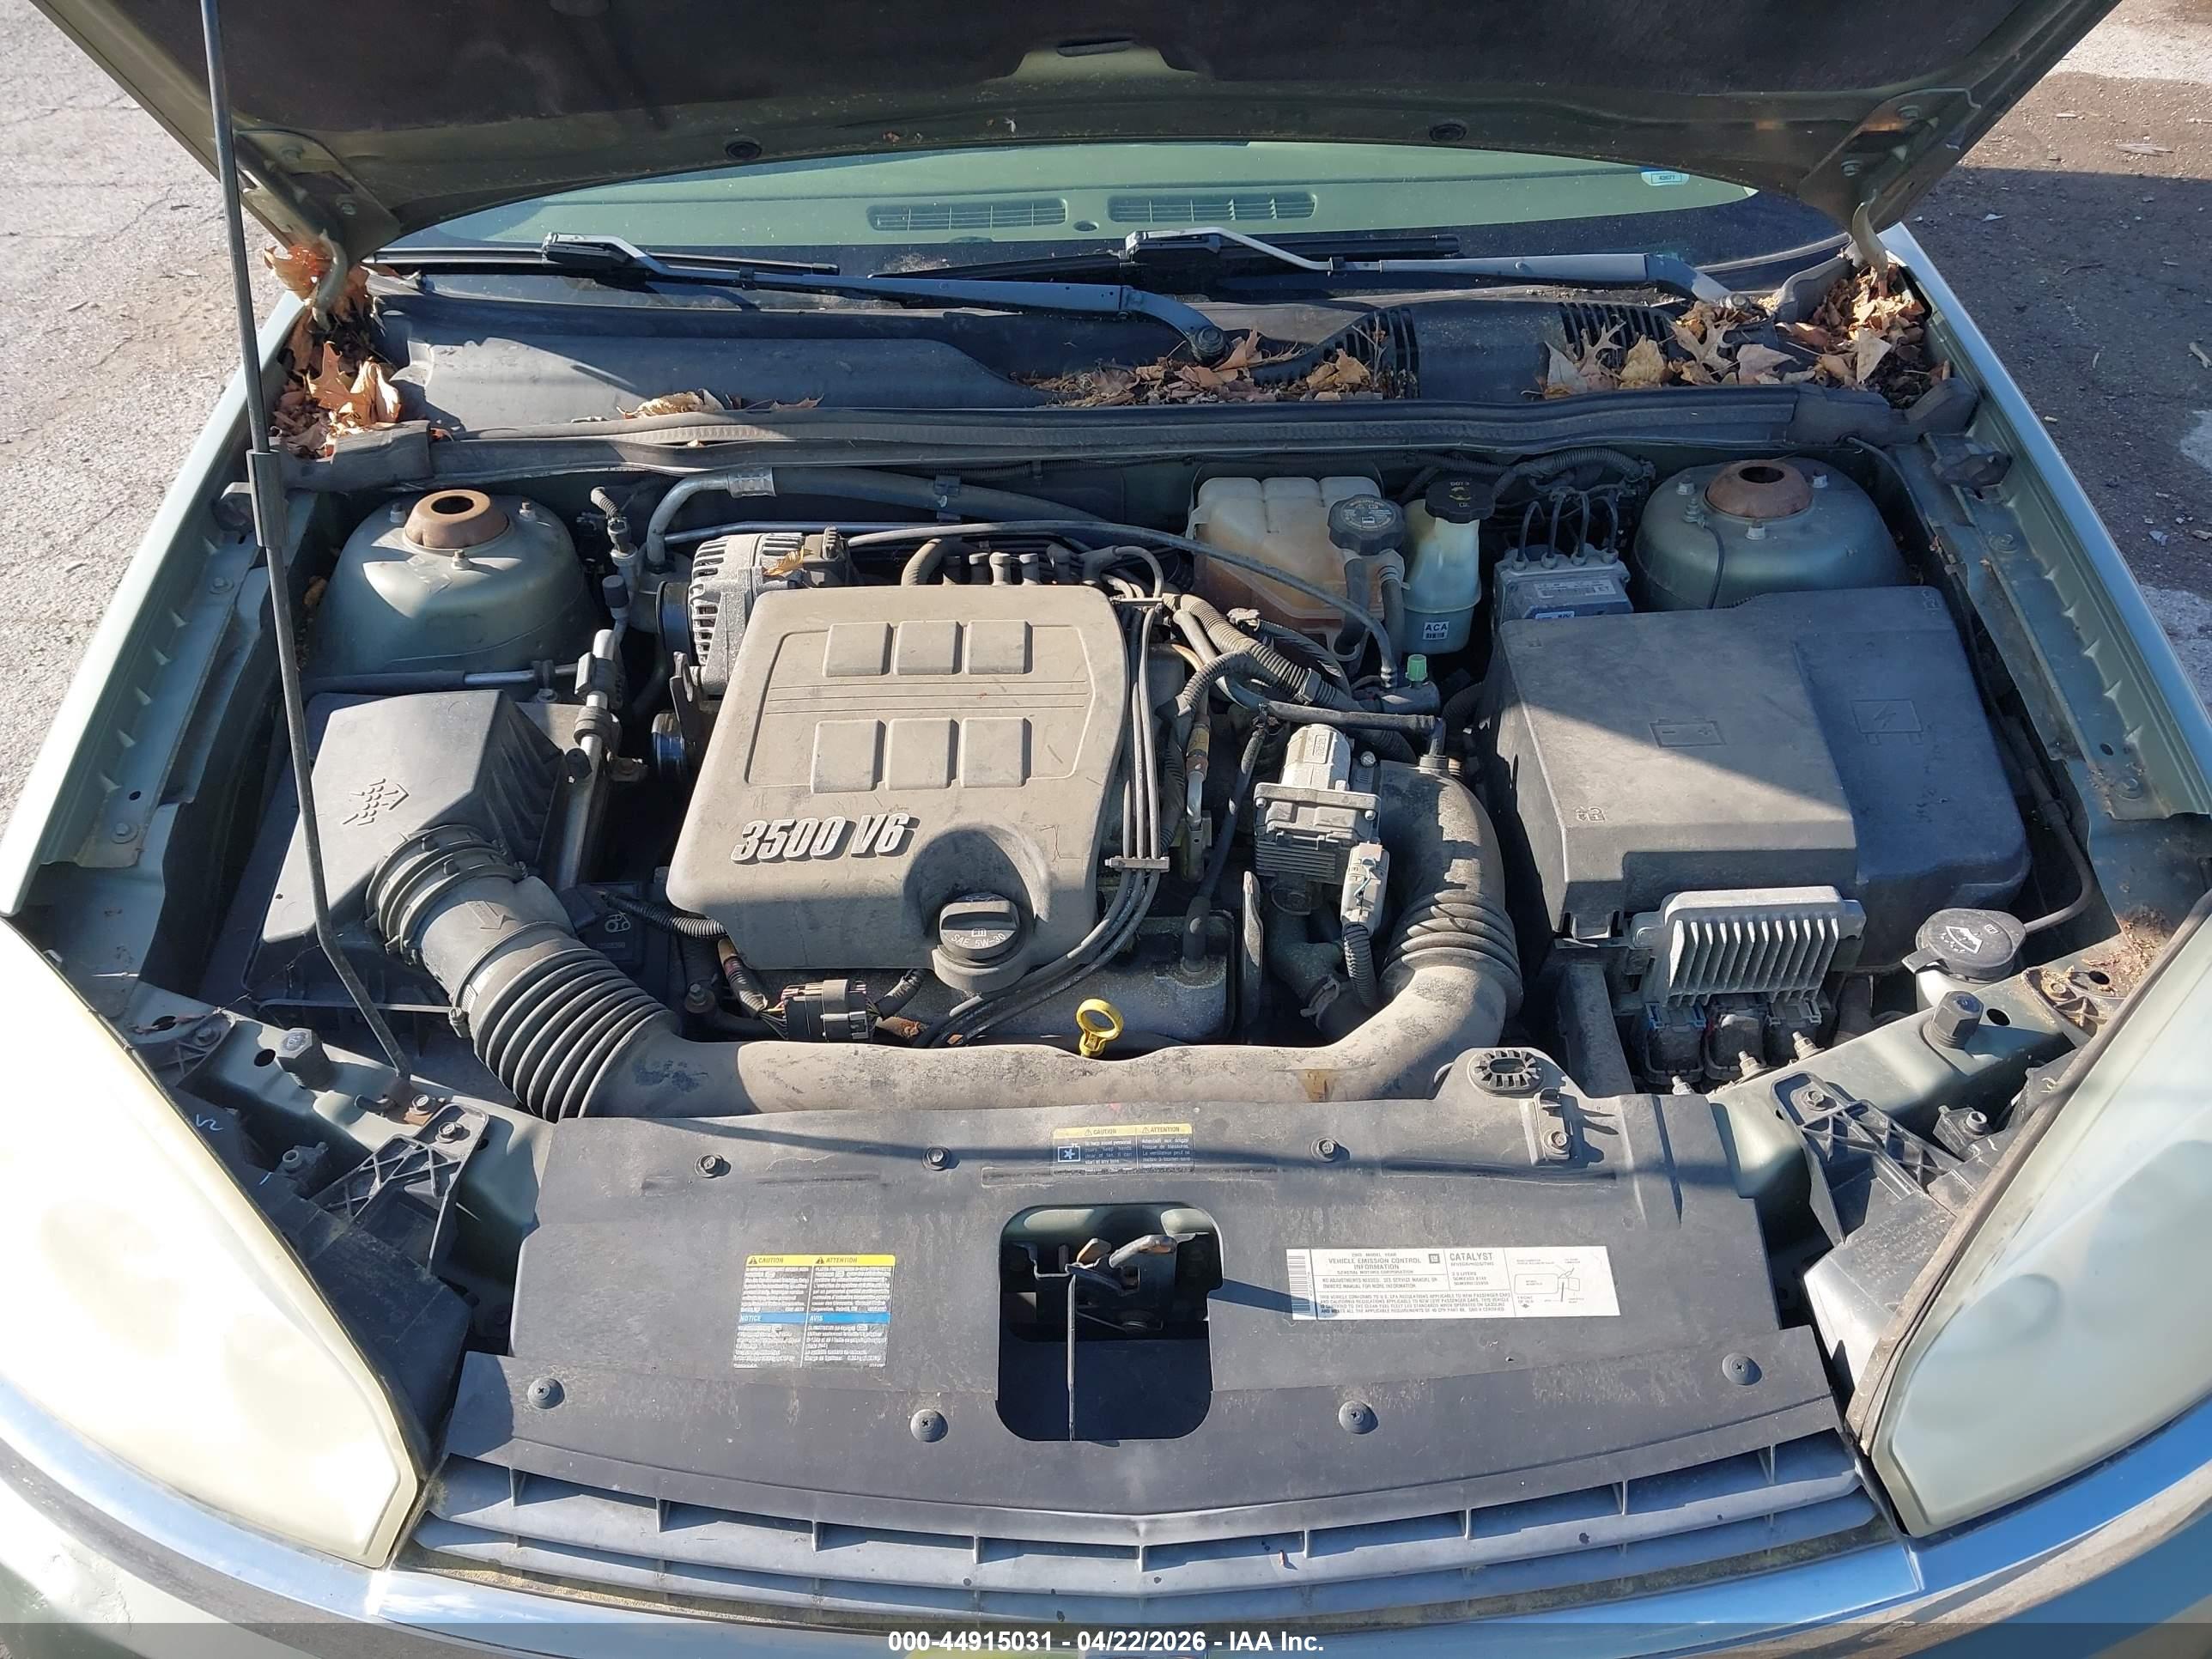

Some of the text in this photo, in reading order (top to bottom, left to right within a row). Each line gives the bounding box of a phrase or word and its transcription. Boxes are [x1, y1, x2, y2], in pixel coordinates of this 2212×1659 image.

[731, 812, 915, 863] 3500 V6
[951, 933, 1006, 947] SAE 5W-30
[1450, 1253, 1493, 1261] CATALYST
